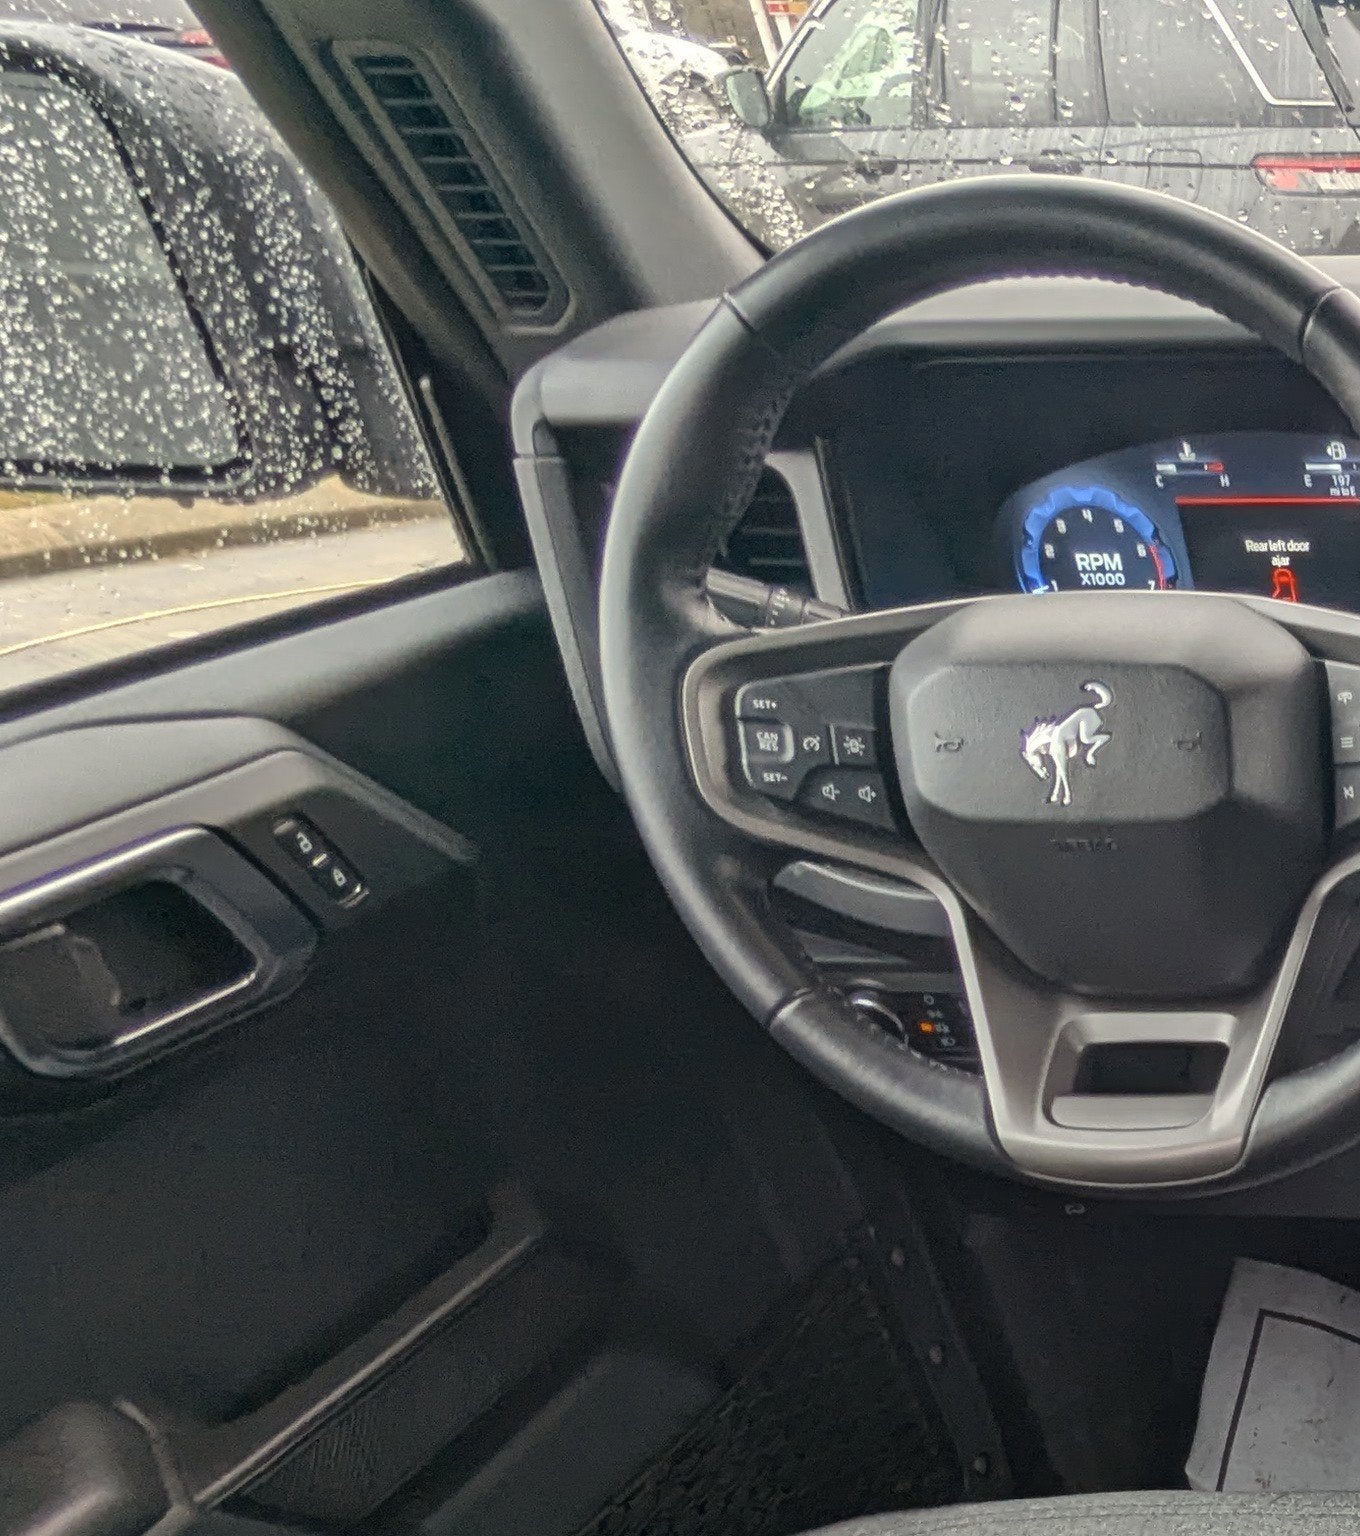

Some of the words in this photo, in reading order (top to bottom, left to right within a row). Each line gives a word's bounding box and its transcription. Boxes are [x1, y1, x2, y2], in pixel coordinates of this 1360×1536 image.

[1220, 474, 1230, 487] H
[1245, 540, 1268, 552] Rear
[1269, 540, 1286, 552] left
[1287, 540, 1310, 552] door
[1074, 552, 1124, 571] RPM
[753, 699, 777, 710] SET+
[756, 731, 779, 741] CAN
